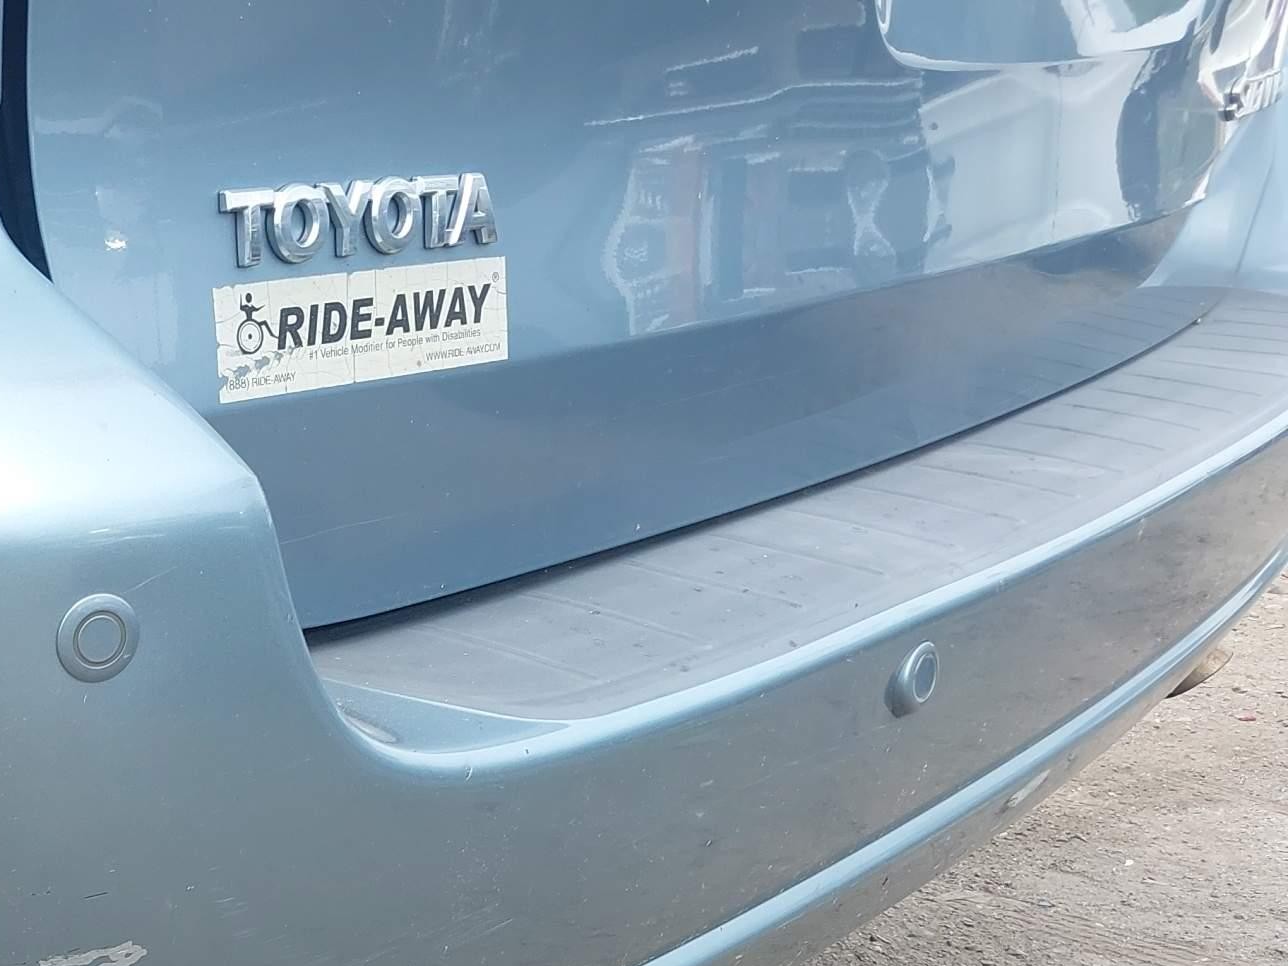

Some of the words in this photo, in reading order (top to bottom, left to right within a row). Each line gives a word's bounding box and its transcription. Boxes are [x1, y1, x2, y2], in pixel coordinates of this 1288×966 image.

[219, 172, 499, 268] TOYOTA
[309, 348, 319, 360] #1
[321, 345, 349, 359] Vehicle
[351, 342, 383, 355] Modifier
[386, 339, 396, 350] for
[397, 335, 424, 351] People
[425, 332, 440, 344] with
[442, 328, 481, 341] Disabilities
[251, 371, 296, 388] RIDE-AWAY
